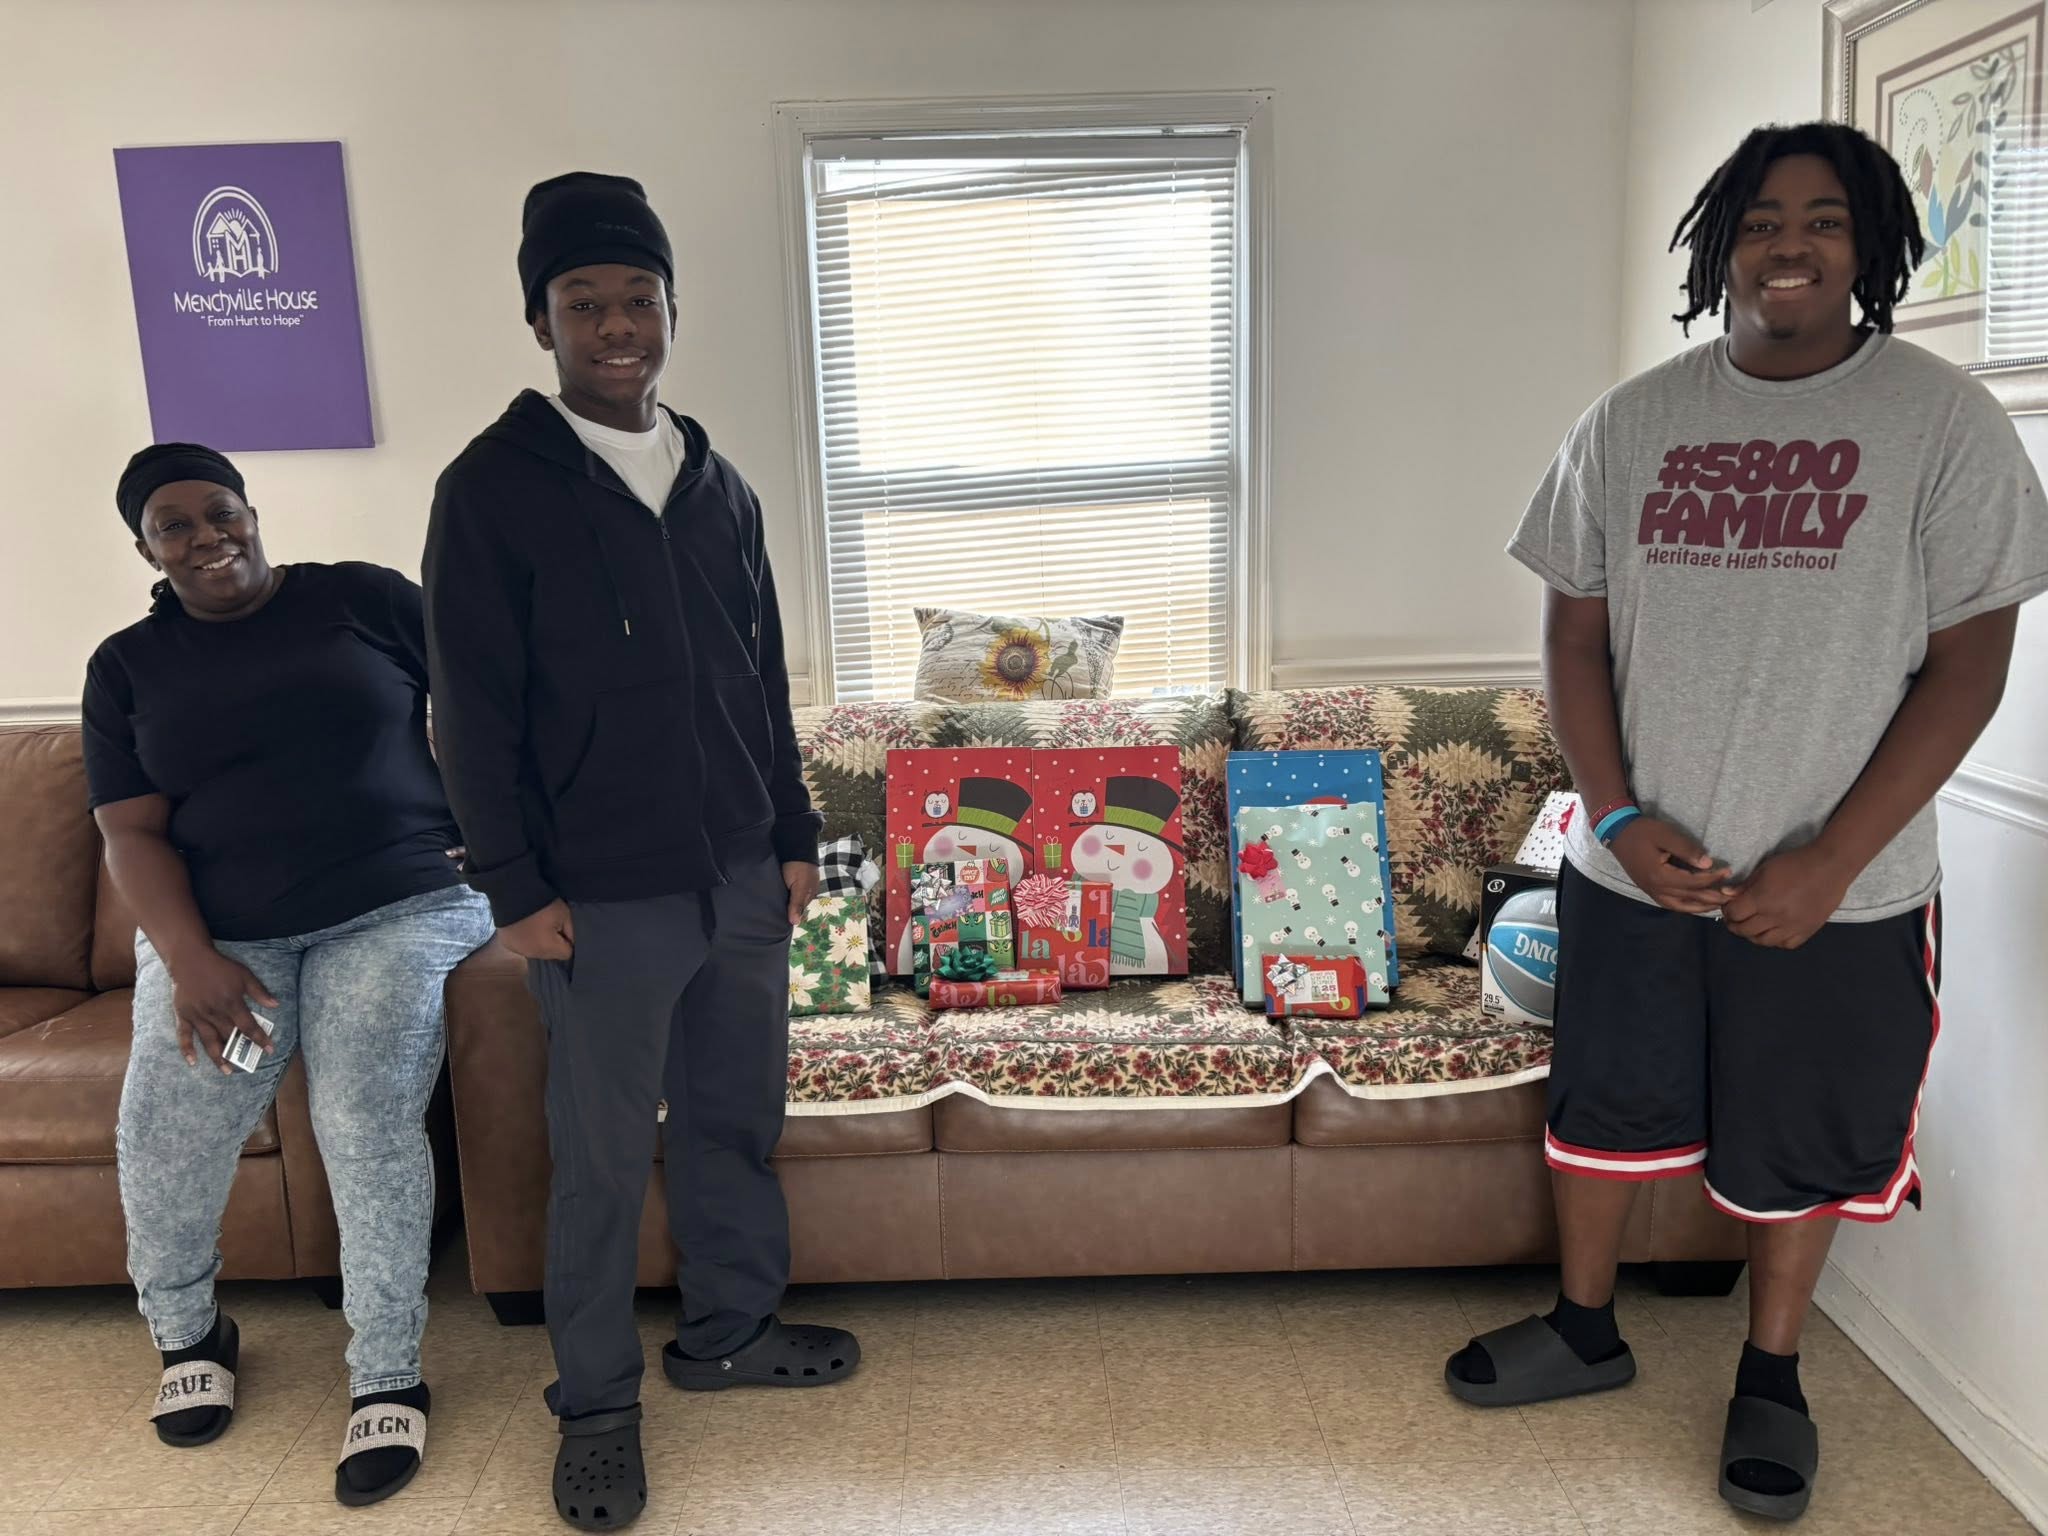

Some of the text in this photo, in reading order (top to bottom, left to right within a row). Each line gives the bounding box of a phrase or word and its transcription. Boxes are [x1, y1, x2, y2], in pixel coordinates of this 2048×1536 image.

[235, 314, 259, 326] Hurt
[261, 315, 271, 326] to
[1657, 438, 1860, 494] #5800
[1638, 491, 1868, 549] FAMILY
[1646, 547, 1837, 570] Heritage High School
[1020, 930, 1051, 960] la
[350, 1415, 410, 1443] RLGN
